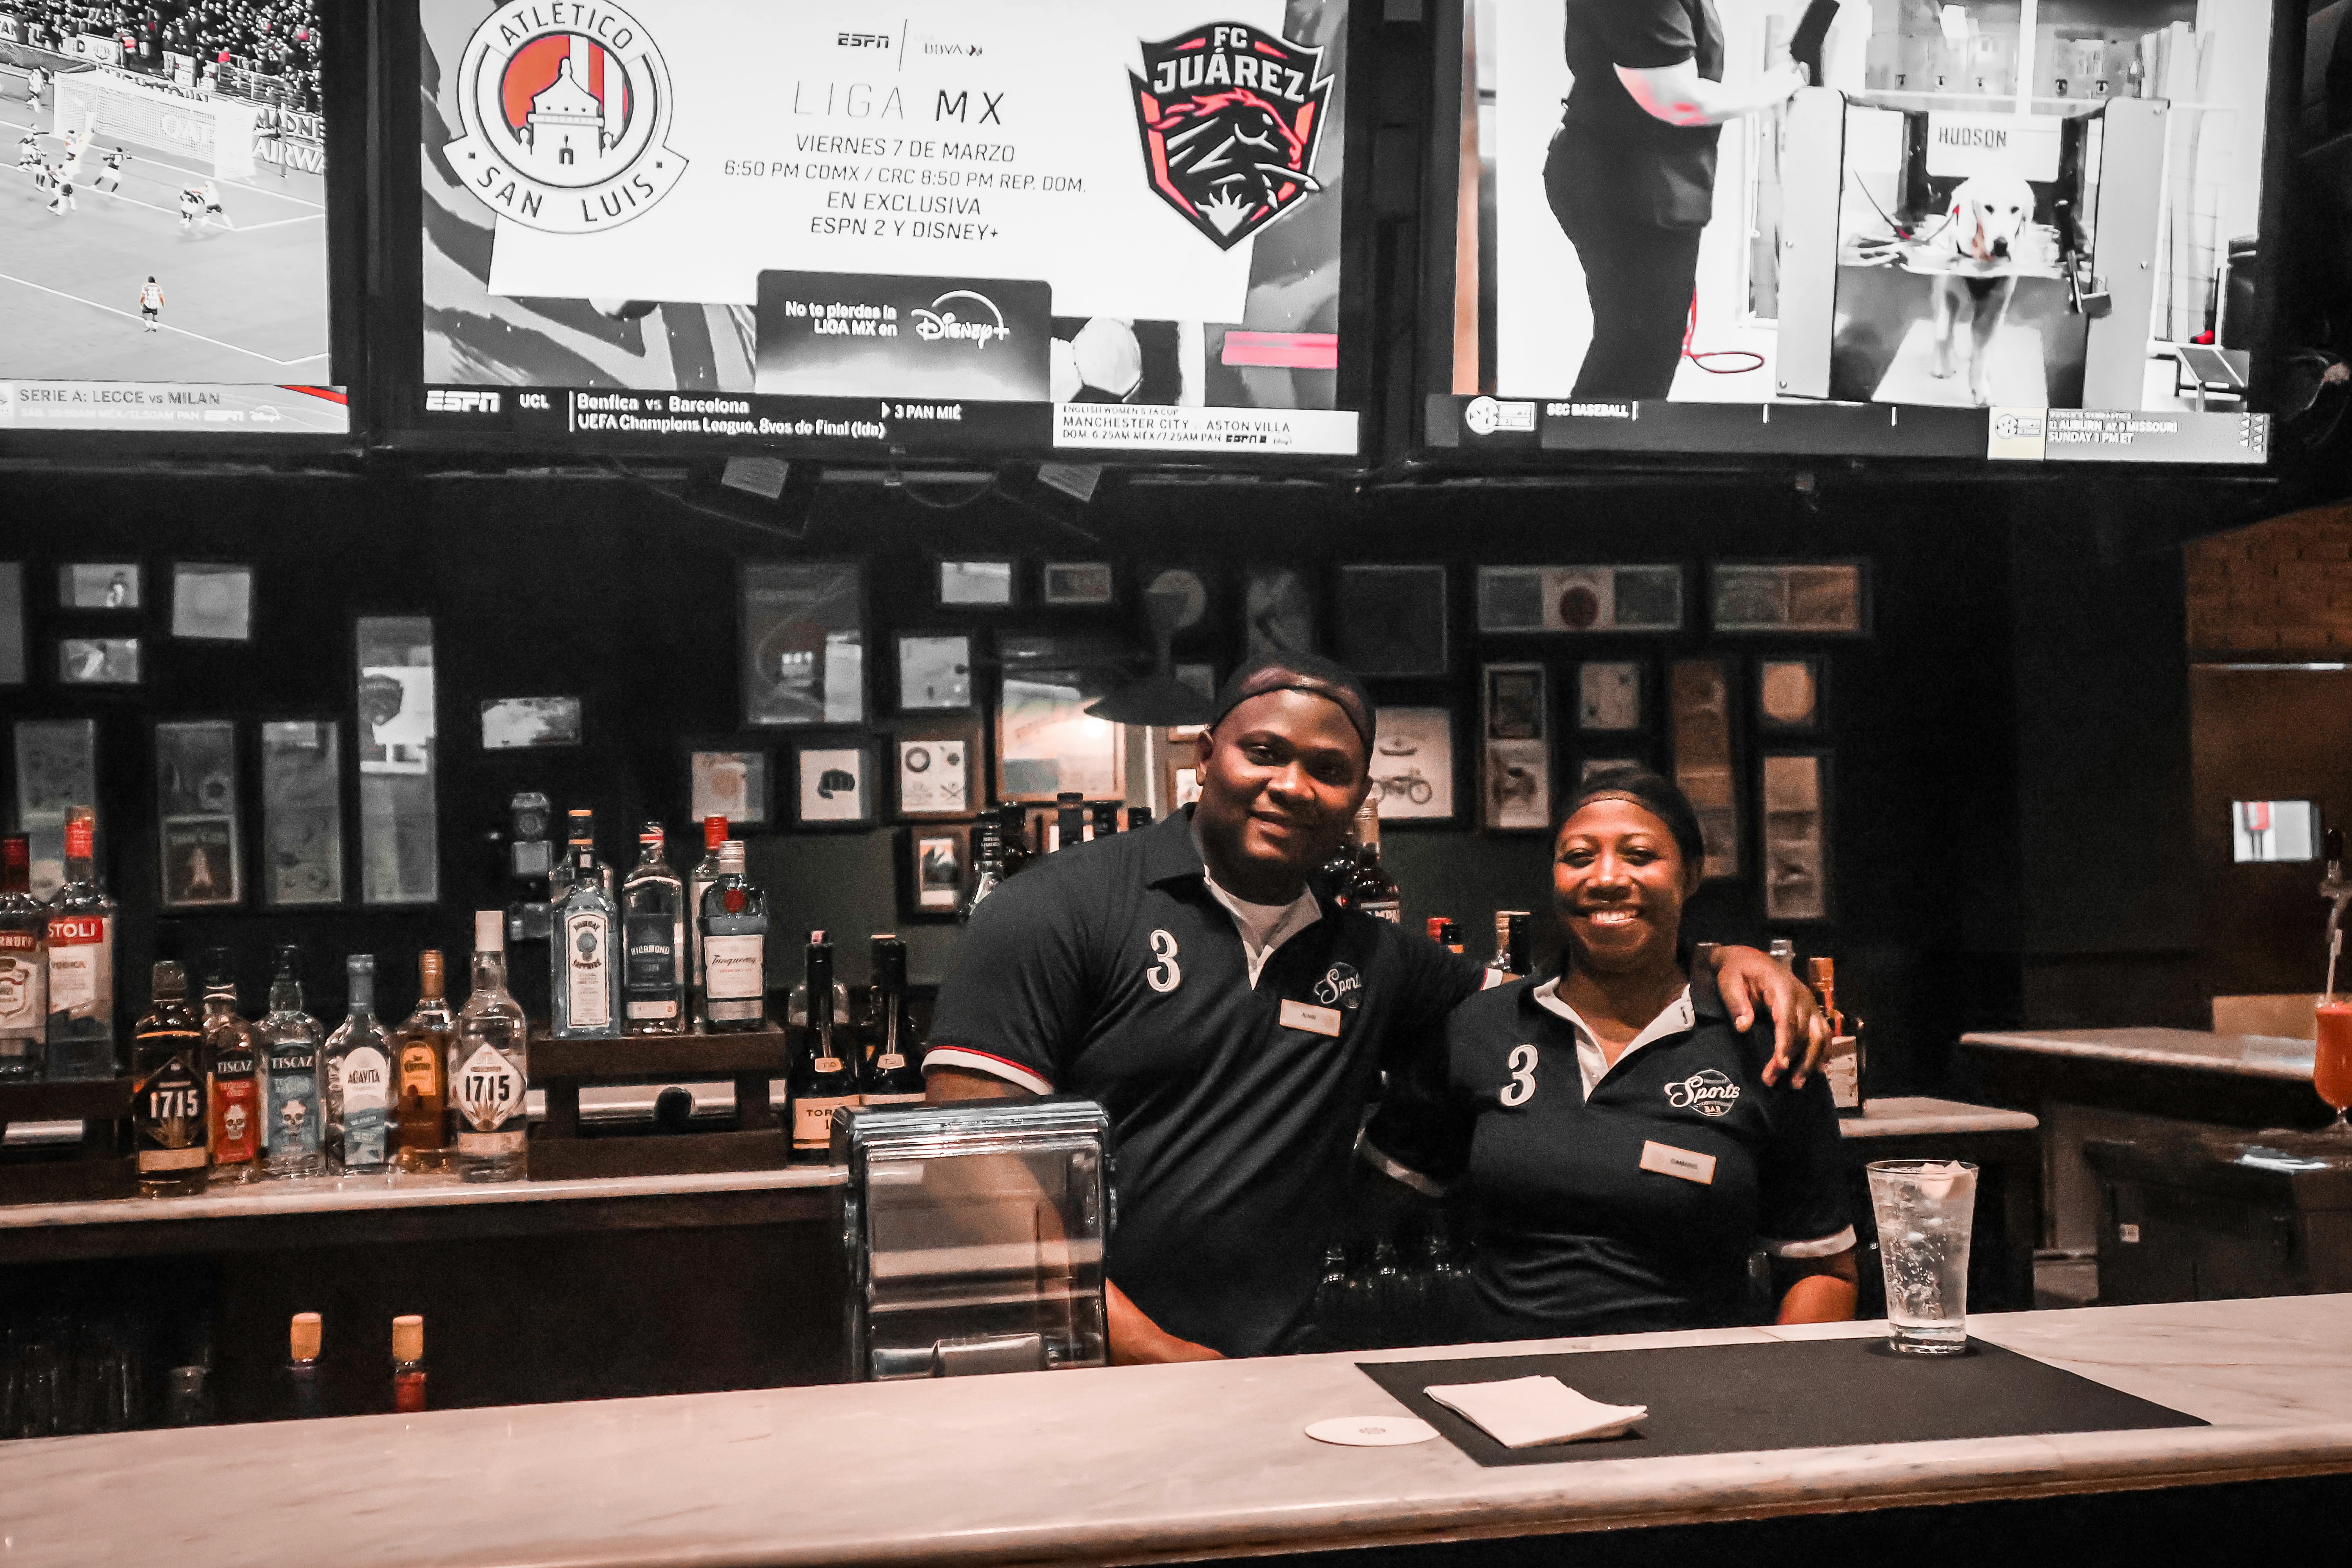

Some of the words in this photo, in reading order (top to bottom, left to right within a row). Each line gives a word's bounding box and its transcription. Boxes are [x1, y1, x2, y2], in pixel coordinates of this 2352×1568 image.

[499, 2, 633, 49] ATLETICO
[1214, 27, 1247, 47] FC
[838, 32, 889, 49] ESPN
[1153, 47, 1305, 103] JUÁREZ
[794, 80, 904, 120] LIGA
[935, 89, 1004, 125] MX
[797, 133, 886, 156] VIERNES
[893, 139, 903, 156] 7
[910, 140, 935, 158] DE
[943, 142, 1015, 162] MARZO
[1939, 126, 2007, 148] HUDSON
[724, 160, 765, 177] 6:50
[772, 163, 799, 178] PM
[806, 164, 859, 181] CDMX
[865, 166, 873, 182] /
[879, 168, 915, 184] CRC
[922, 170, 960, 186] 8:50
[967, 172, 993, 188] PM
[1000, 174, 1035, 191] REP.
[1043, 176, 1086, 193] DOM.
[477, 167, 542, 218] SAN
[581, 173, 653, 222] LUIS
[827, 191, 855, 209] EN
[864, 192, 980, 215] EXCLUSIVA
[811, 216, 866, 235] ESPN
[874, 219, 885, 235] 2
[894, 220, 907, 236] Y
[913, 221, 999, 240] DISNEY+
[785, 300, 806, 317] No
[911, 290, 1011, 349] Disney+
[814, 319, 849, 335] LIGA
[851, 320, 876, 336] MX
[20, 389, 67, 401] SERIE
[72, 390, 87, 403] A:
[93, 390, 144, 403] LECCE
[149, 395, 163, 404] vs
[168, 391, 220, 405] MILAN
[426, 390, 501, 412] ESPN
[519, 393, 550, 409] UCL
[577, 392, 640, 410] Benfica
[669, 395, 751, 414] Barcelona
[895, 404, 903, 419] 3
[906, 404, 933, 419] PAN
[1546, 403, 1570, 417] SEC
[1570, 403, 1630, 417] BASEBALL
[578, 413, 619, 429] UEFA
[619, 414, 701, 434] Champions
[759, 417, 792, 435] 8vos
[1063, 416, 1154, 428] MANCHESTER
[1160, 419, 1189, 429] CITY
[1207, 420, 1249, 431] ASTON
[1254, 421, 1290, 433] VILLA
[2058, 419, 2103, 431] AUBURN
[2127, 420, 2178, 433] MISSOURI
[2049, 431, 2093, 443] SUNDAY
[48, 923, 95, 938] STOLI
[1147, 929, 1181, 993] 3
[348, 1069, 380, 1085] AGAVITA
[1500, 1044, 1539, 1107] 3
[465, 1074, 510, 1102] 1715
[1663, 1075, 1740, 1107] Sports
[150, 1089, 198, 1118] 1715
